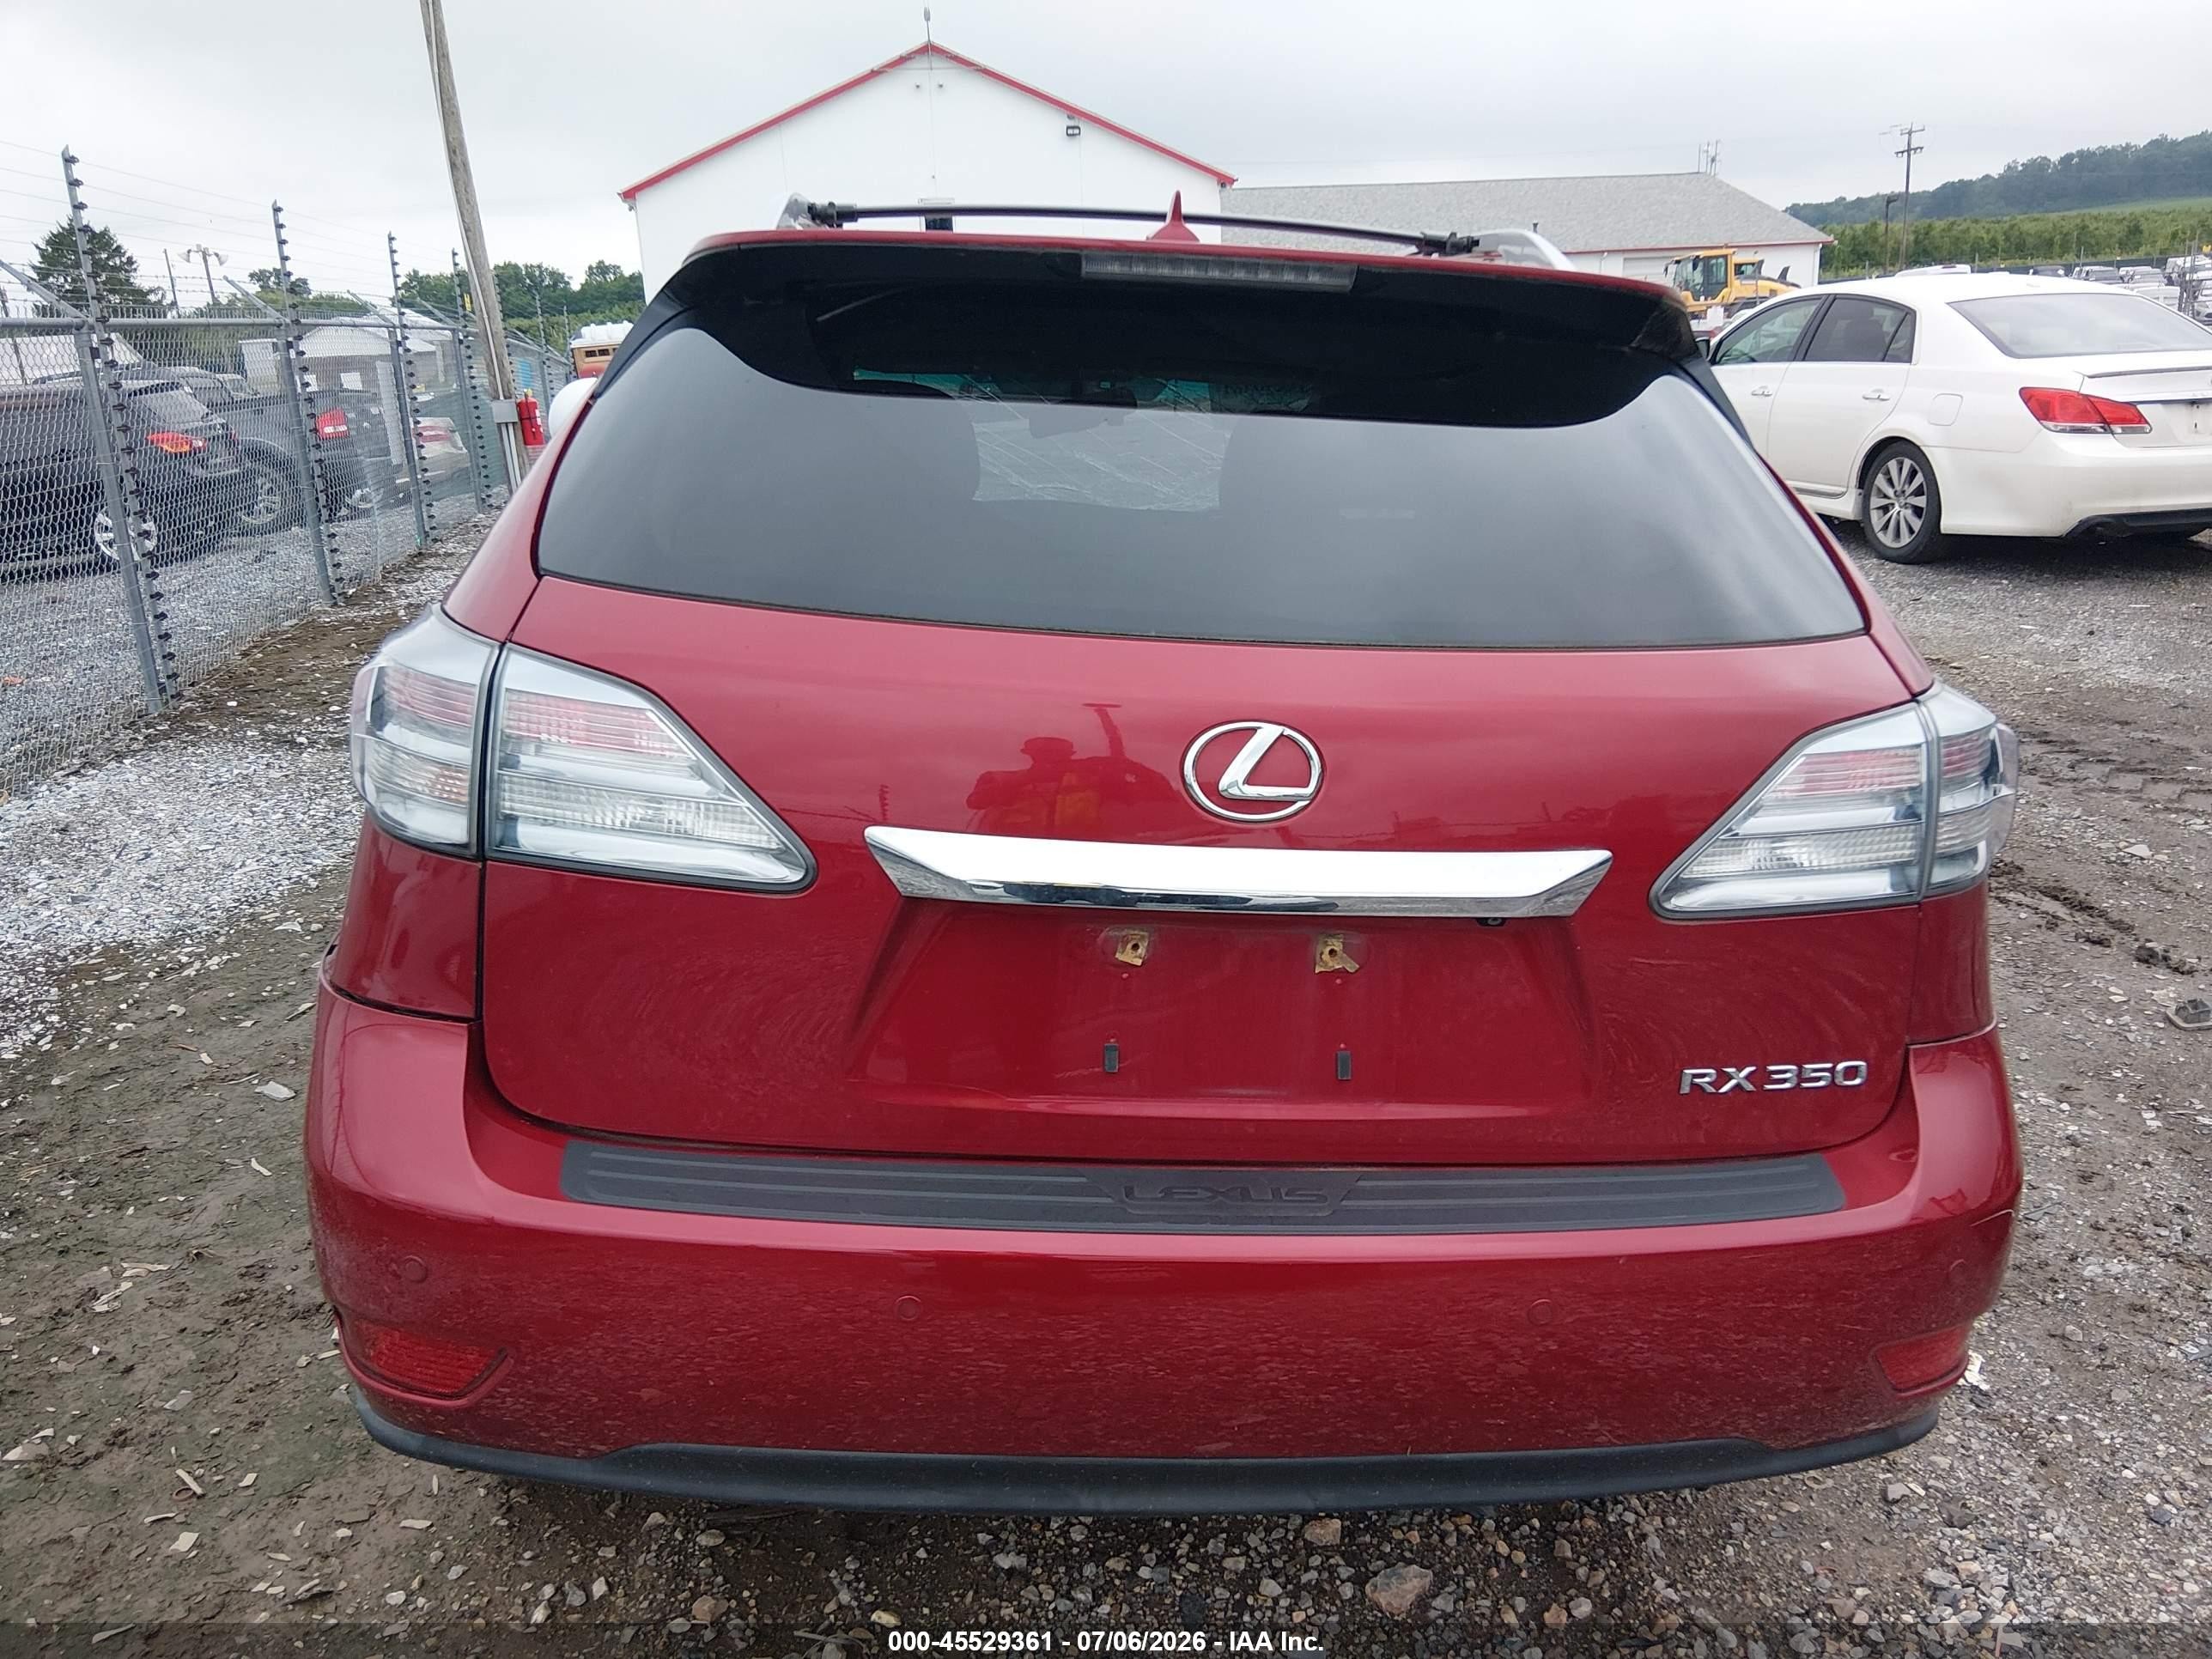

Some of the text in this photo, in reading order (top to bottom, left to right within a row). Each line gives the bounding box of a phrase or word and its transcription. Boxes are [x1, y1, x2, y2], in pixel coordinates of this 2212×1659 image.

[1679, 1060, 1869, 1095] RX 350
[1123, 1185, 1329, 1203] LEXUS
